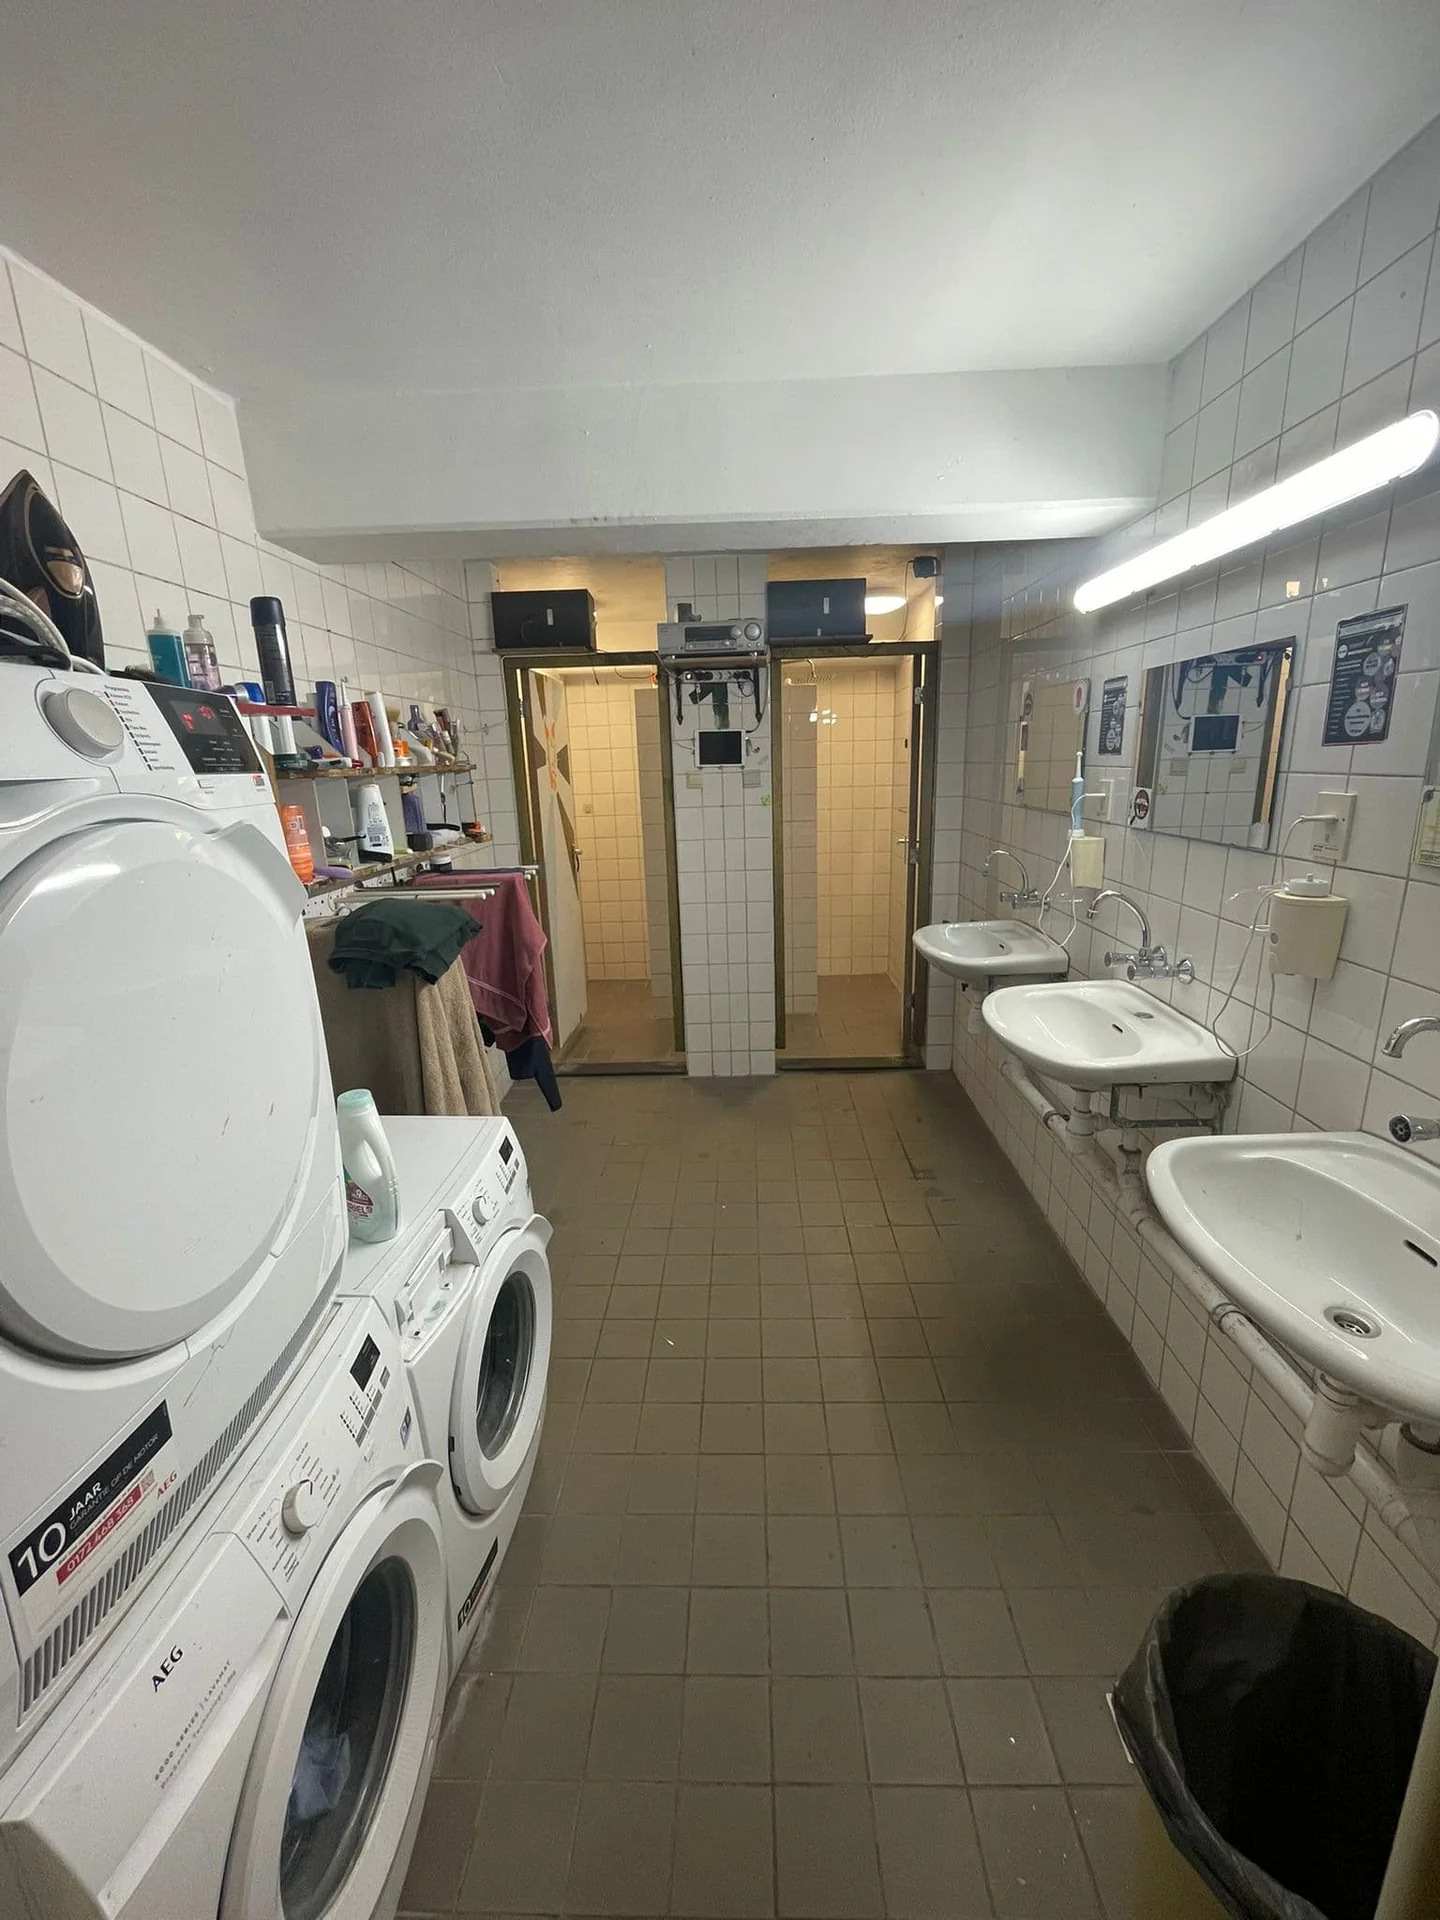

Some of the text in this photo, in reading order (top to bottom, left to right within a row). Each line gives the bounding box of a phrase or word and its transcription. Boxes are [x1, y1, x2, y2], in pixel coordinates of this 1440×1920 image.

[69, 1482, 102, 1520] JAAR
[70, 1433, 159, 1530] GARANTIE OP DE MOTOR
[157, 1470, 178, 1500] AEG
[17, 1522, 66, 1579] 10
[67, 1543, 92, 1572] 0172
[152, 1645, 183, 1693] AEG
[175, 1711, 199, 1747] SERIES
[204, 1660, 230, 1702] LAVAMAT
